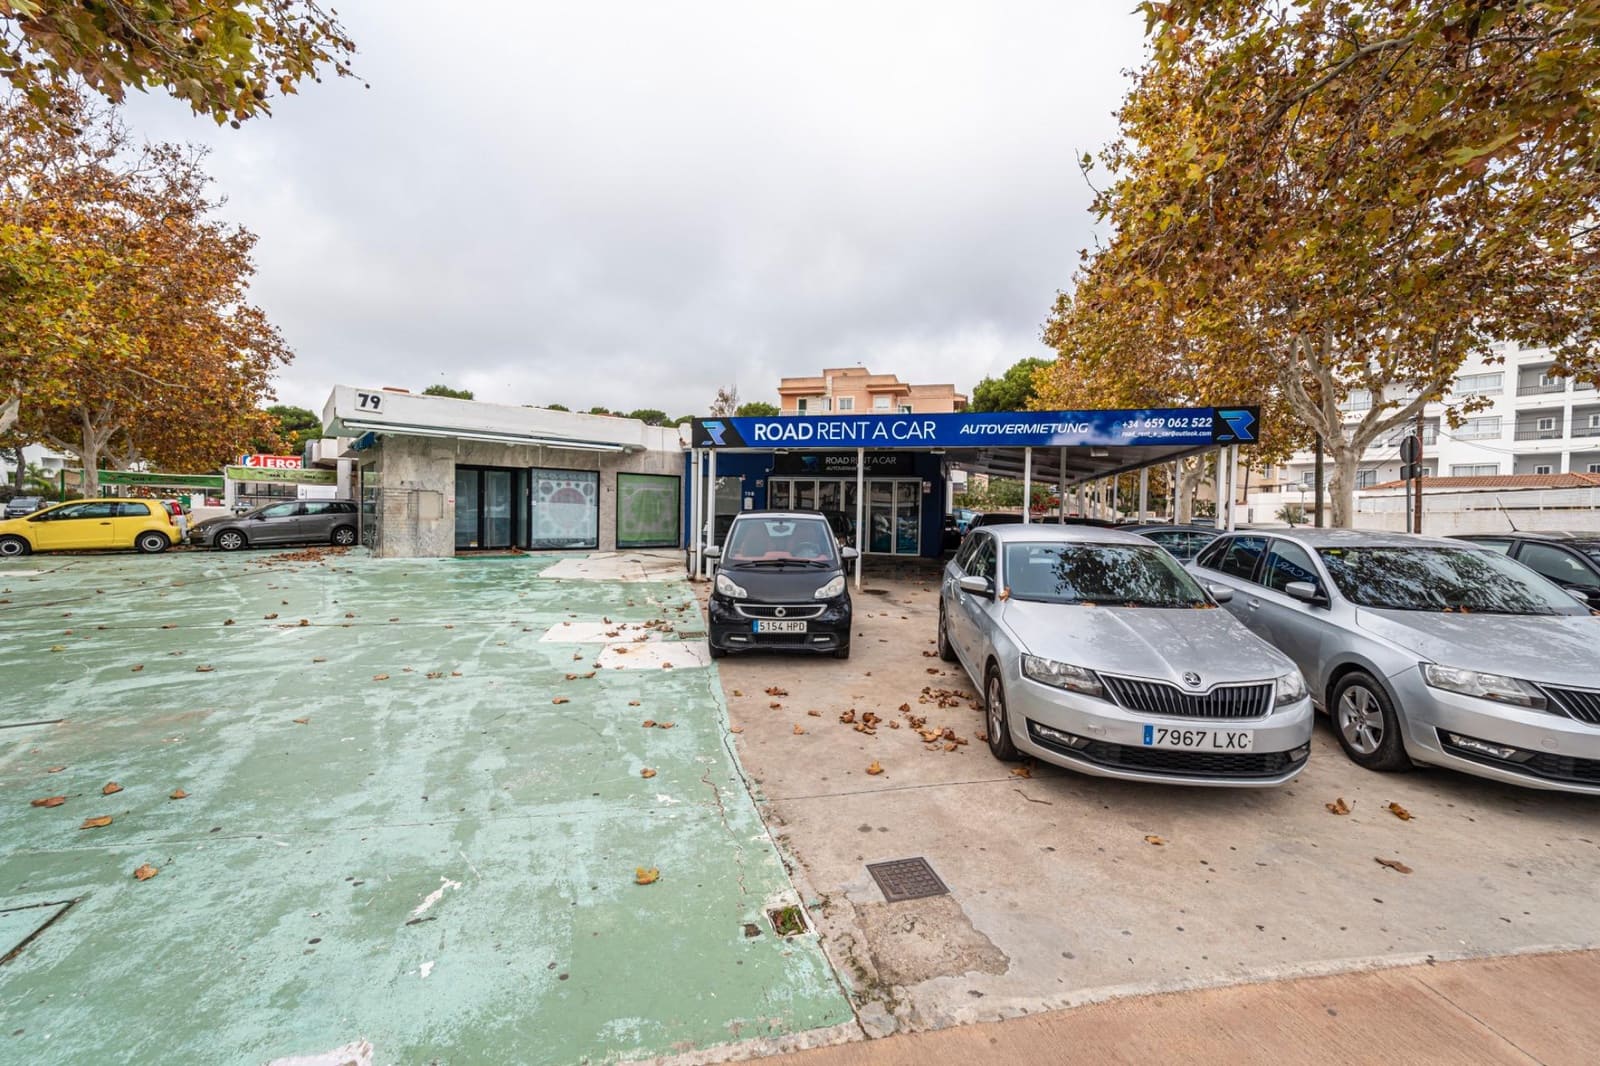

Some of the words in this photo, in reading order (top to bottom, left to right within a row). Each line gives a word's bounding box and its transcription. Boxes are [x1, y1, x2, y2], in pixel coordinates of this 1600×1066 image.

[358, 393, 381, 409] 79
[960, 422, 1089, 434] AUTOVERMIETUNG
[1122, 420, 1138, 429] +34
[1144, 418, 1165, 428] 659
[1167, 417, 1188, 428] 062
[1191, 417, 1213, 428] 522
[754, 423, 813, 441] ROAD
[817, 421, 870, 440] RENT
[872, 421, 889, 439] A
[891, 420, 937, 440] CAR
[825, 456, 850, 465] ROAD
[879, 456, 897, 464] CAR
[760, 622, 783, 631] 5154
[786, 622, 805, 631] HPD
[1157, 728, 1207, 747] 7967
[1213, 732, 1248, 749] LXC
